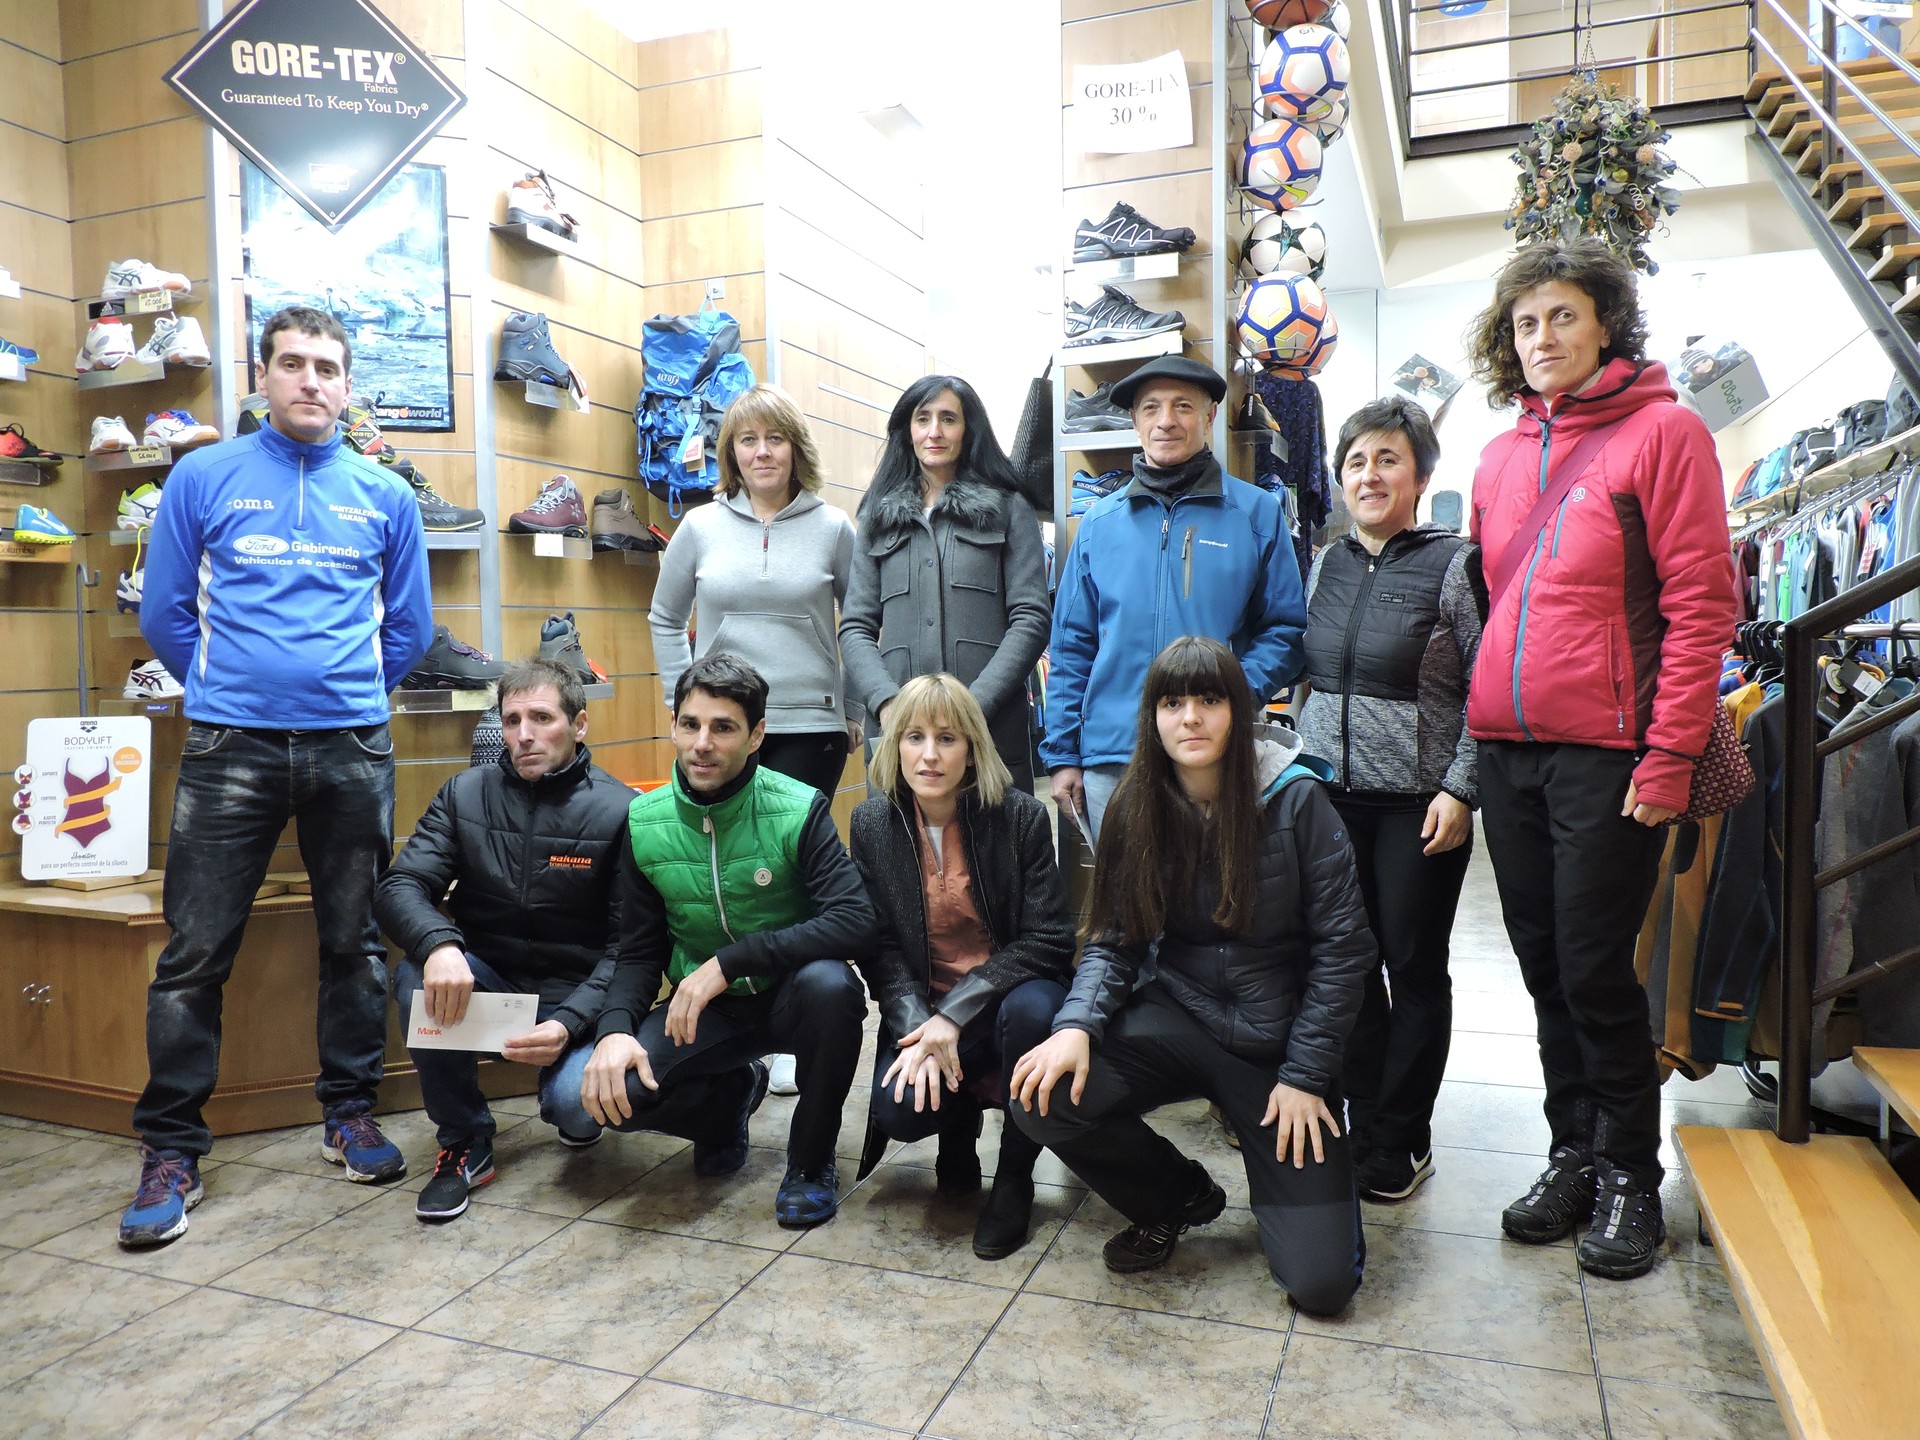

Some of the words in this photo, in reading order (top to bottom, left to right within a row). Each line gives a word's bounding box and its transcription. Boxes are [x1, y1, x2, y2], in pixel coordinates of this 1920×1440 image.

[364, 82, 399, 95] Fabrics
[221, 88, 302, 107] Guaranteed
[304, 93, 324, 108] To
[327, 95, 363, 115] Keep
[364, 97, 392, 114] You
[1109, 106, 1132, 125] 30
[337, 512, 368, 524] SAKANA
[291, 540, 360, 559] Gabirondo
[234, 555, 294, 566] Vehiculos
[296, 556, 313, 567] de
[315, 559, 359, 571] ocasion
[64, 736, 112, 746] BODYLIFT
[60, 861, 80, 869] perfecto
[550, 854, 592, 865] sakana
